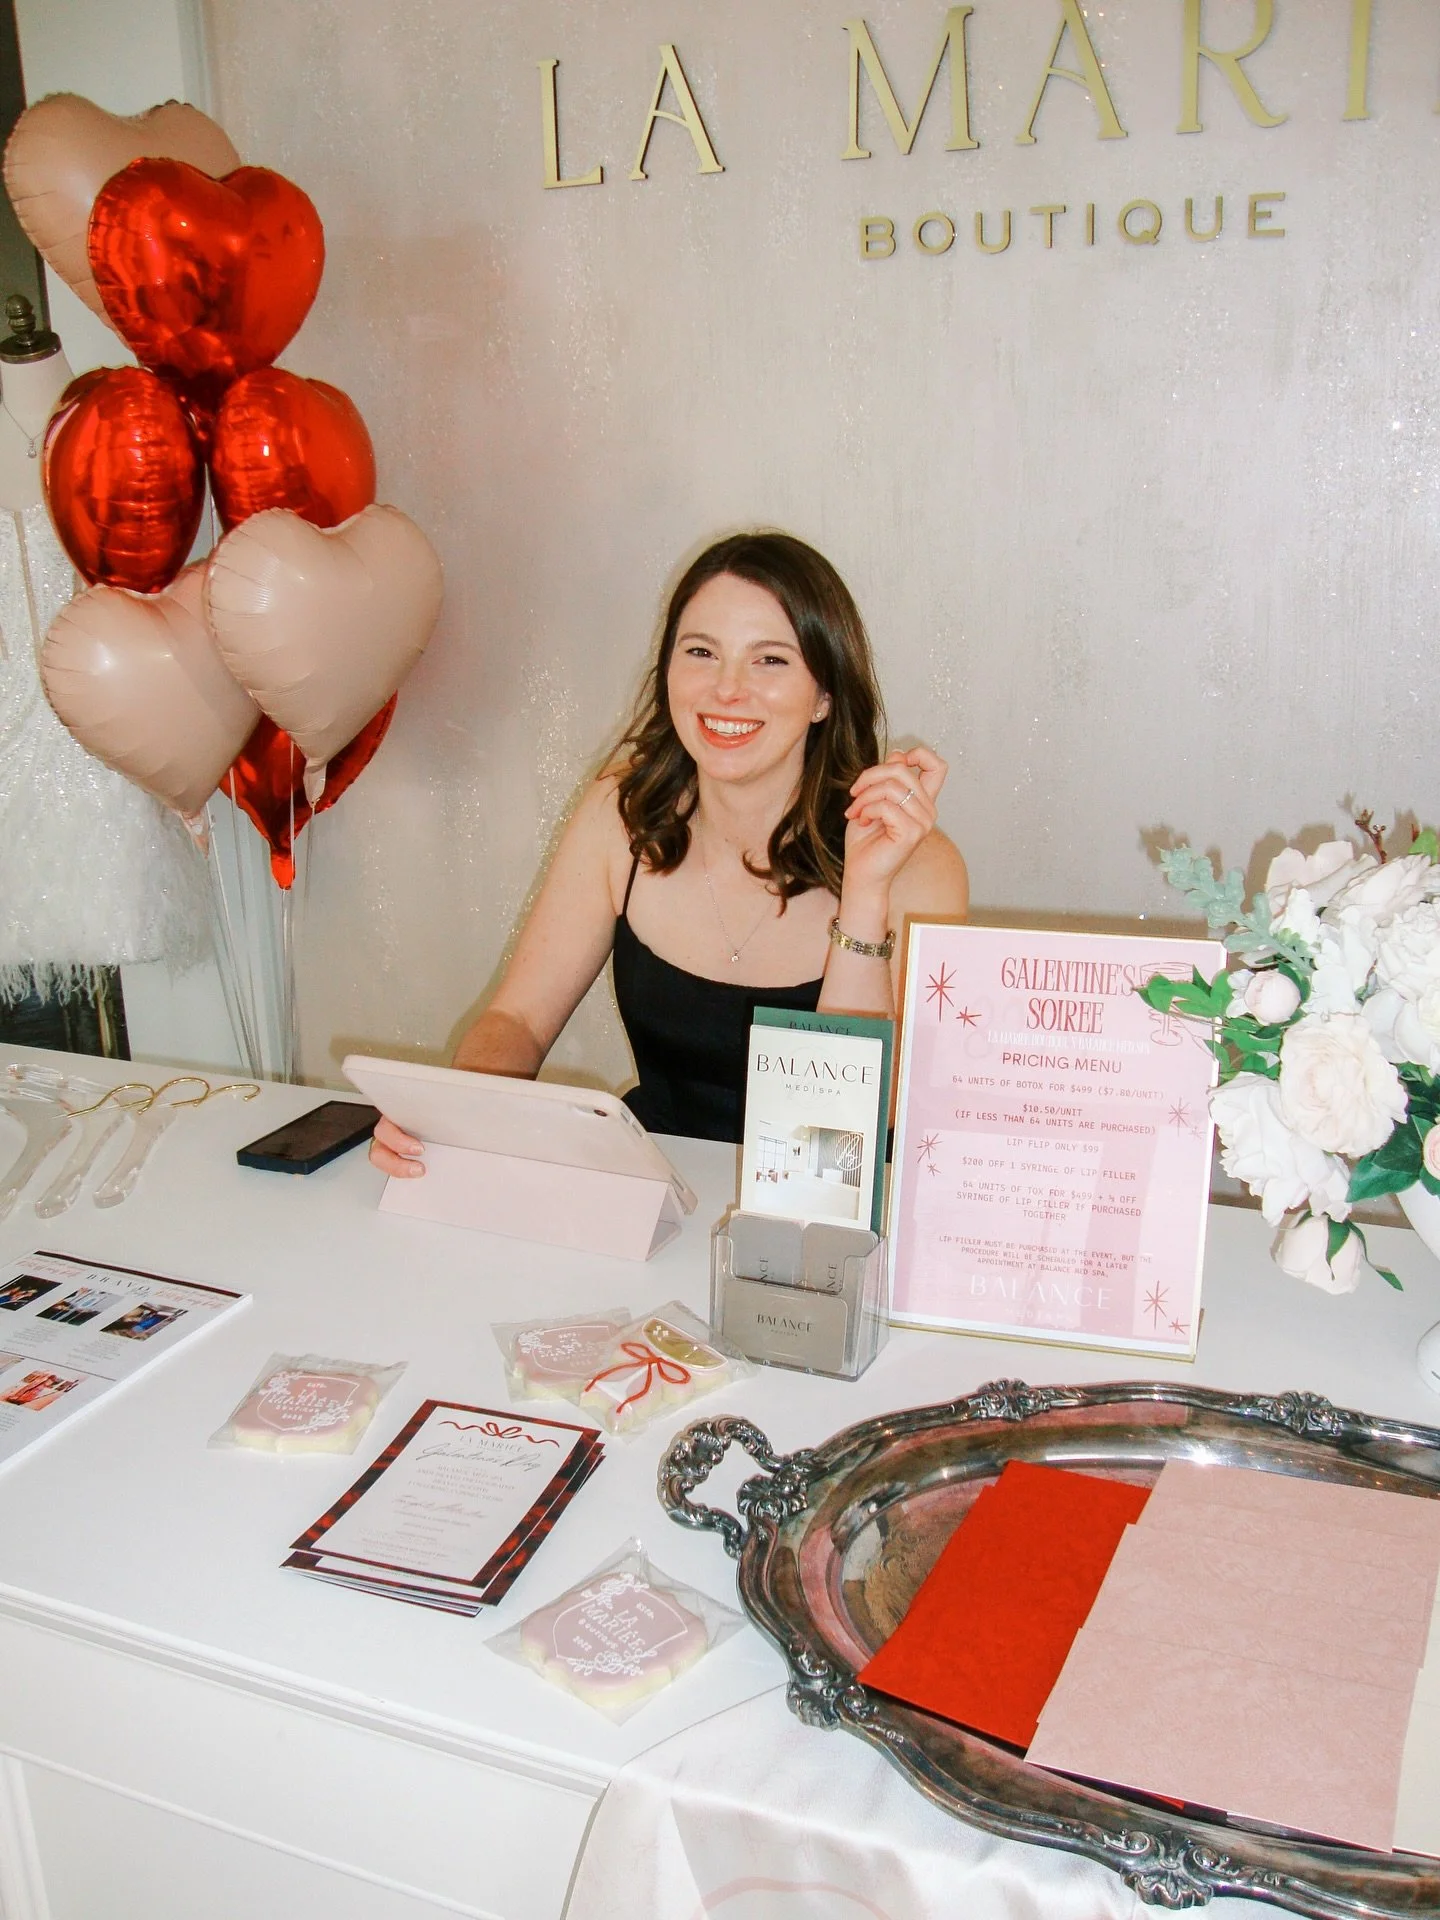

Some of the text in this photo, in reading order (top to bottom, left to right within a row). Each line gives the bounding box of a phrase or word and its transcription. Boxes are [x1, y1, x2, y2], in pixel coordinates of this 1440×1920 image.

[537, 0, 1440, 189] LA MARI
[860, 192, 1286, 260] BOUTIQUE
[1001, 957, 1136, 996] GALENTINE'S
[1026, 998, 1104, 1034] SOIREE
[757, 1053, 874, 1085] BALANCE
[1002, 1052, 1122, 1074] PRICING MENU
[952, 1075, 963, 1083] 64
[968, 1076, 995, 1086] UNITS
[1000, 1079, 1011, 1087] OF
[1016, 1081, 1043, 1090] BOTOX
[1049, 1083, 1065, 1092] FOR
[1071, 1084, 1092, 1094] $499
[955, 1109, 1156, 1135] (IF LESS THAN 64 UNITS ARE PURCHASED)
[1006, 1138, 1022, 1147] LIP
[1028, 1140, 1050, 1149] FLIP
[1055, 1142, 1077, 1152] ONLY
[962, 1156, 983, 1166] $200
[988, 1159, 1005, 1168] OFF
[1021, 1162, 1058, 1173] SYRINGE
[1064, 1166, 1075, 1175] OF
[1080, 1168, 1097, 1177] LIP
[1102, 1170, 1136, 1180] FILLER
[962, 1180, 973, 1188] 64
[978, 1182, 1006, 1191] UNITS
[1010, 1185, 1022, 1193] OF
[1028, 1186, 1044, 1196] TOX
[1049, 1189, 1065, 1198] FOR
[1119, 1195, 1137, 1204] OFF
[956, 1192, 1141, 1217] SYRINGE OF LIP FILLER IF PURCHASED
[1023, 1209, 1066, 1221] TOGETHER
[961, 1247, 999, 1257] PROCEDURE
[1002, 1251, 1020, 1259] WILL
[1037, 1254, 1077, 1265] SCHEDULED
[1105, 1262, 1128, 1270] LATER
[984, 1239, 1002, 1247] MUST
[1018, 1244, 1057, 1254] PURCHASED
[1074, 1249, 1088, 1257] THE
[1121, 1254, 1135, 1262] BUT
[977, 1258, 1024, 1269] APPOINTMENT
[1040, 1264, 1070, 1274] BALANCE
[970, 1274, 1113, 1310] BALANCE
[757, 1314, 813, 1332] BALANCE
